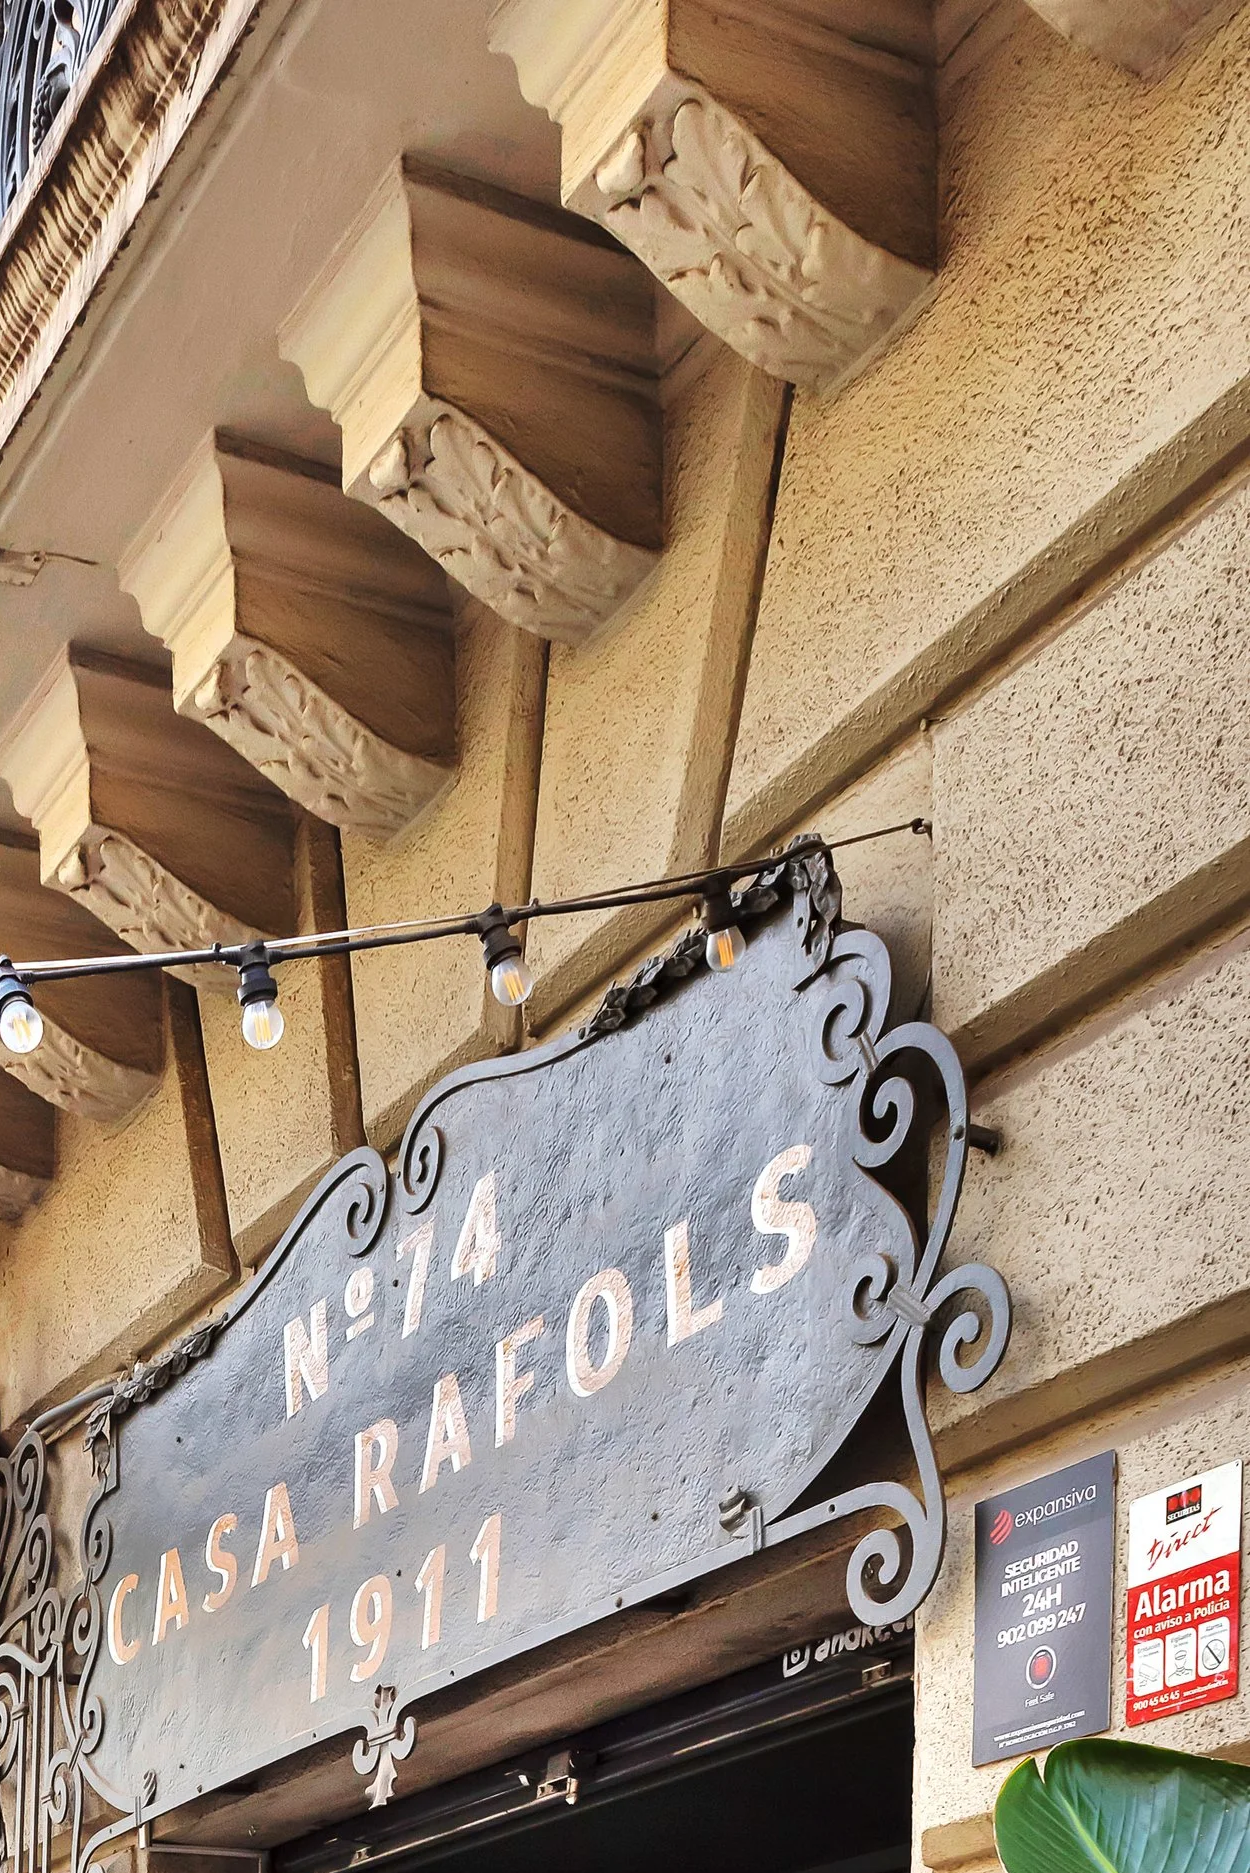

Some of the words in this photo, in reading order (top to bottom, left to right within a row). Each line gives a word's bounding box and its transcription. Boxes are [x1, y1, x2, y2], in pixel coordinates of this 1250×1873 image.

[108, 1483, 299, 1666] CASA
[353, 1144, 817, 1530] RAFOLS
[1015, 1484, 1097, 1528] expansiva
[1147, 1505, 1224, 1570] Direct
[1001, 1556, 1081, 1597] INTELIGENTE
[1004, 1540, 1079, 1579] SEGURIDAD
[303, 1515, 503, 1703] 1911
[1022, 1583, 1062, 1617] 24H
[1134, 1569, 1230, 1622] Alarma
[1134, 1622, 1154, 1639] con
[1155, 1613, 1183, 1632] aviso
[1184, 1612, 1192, 1623] a
[1193, 1598, 1230, 1621] Policía
[1133, 1700, 1148, 1712] 900
